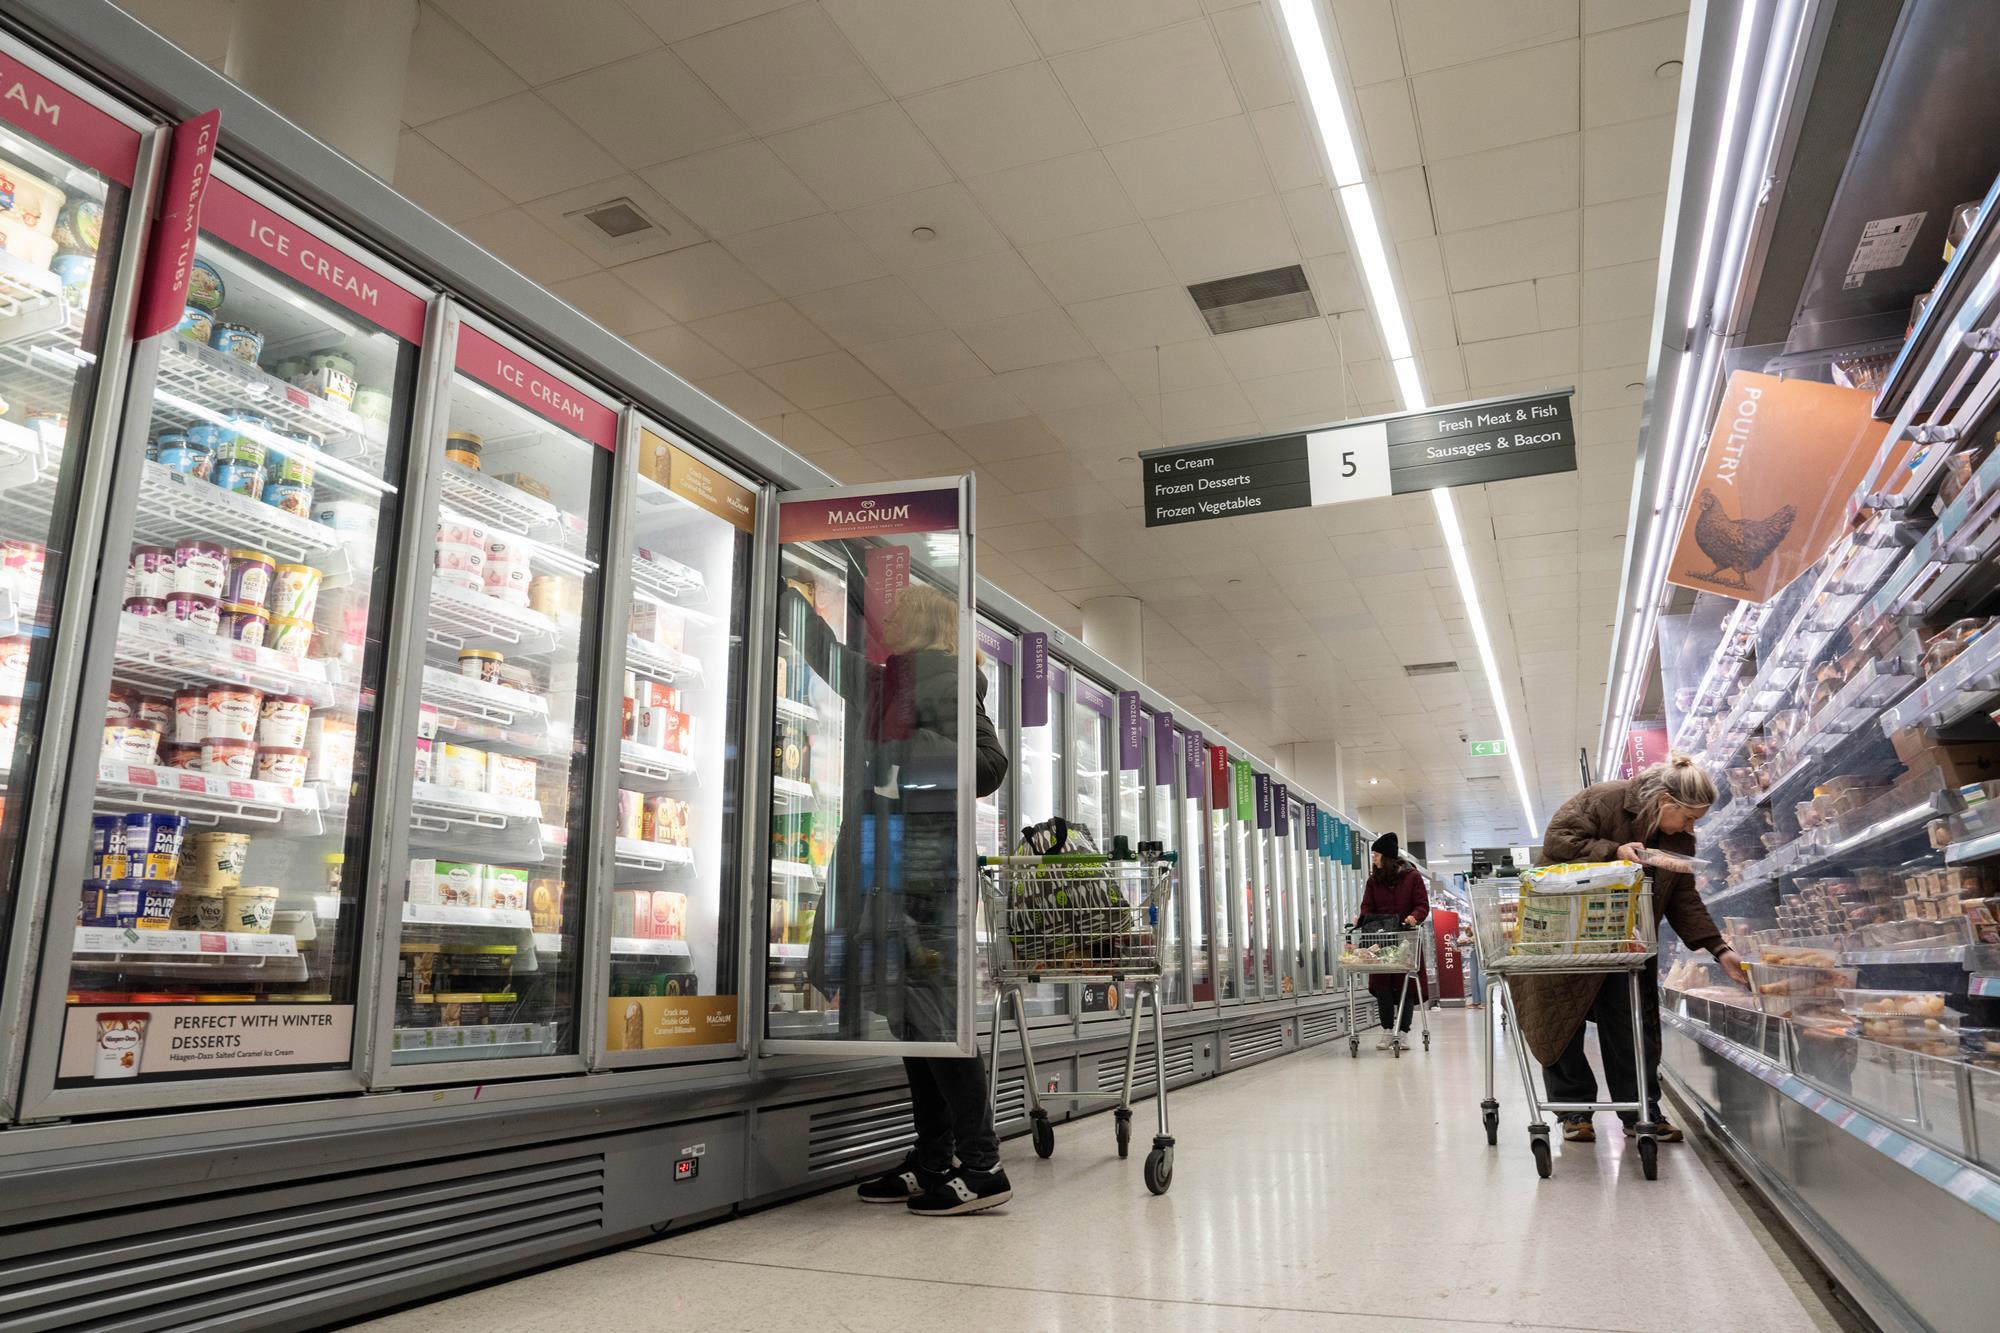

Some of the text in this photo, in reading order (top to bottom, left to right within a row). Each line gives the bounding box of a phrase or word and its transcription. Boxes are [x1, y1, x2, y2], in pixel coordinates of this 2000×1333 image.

[0, 72, 60, 127] AM
[171, 122, 211, 293] ICE CREAM TUBS
[249, 218, 380, 307] ICE CREAM
[497, 359, 585, 422] ICE CREAM
[1438, 404, 1558, 433] Fresh Meat & Fish
[1426, 431, 1561, 459] Sausages & Bacon
[1716, 386, 1762, 486] POULTRY
[1154, 457, 1215, 474] Ice Cream
[1341, 451, 1357, 477] 5
[1155, 475, 1251, 496] Frozen Desserts
[726, 496, 750, 514] MAGNUM
[827, 504, 912, 525] MAGNUM
[1156, 495, 1262, 519] Frozen Vegetables
[976, 630, 1001, 651] ESSERTS
[1035, 638, 1043, 680] DESSERTS
[1129, 695, 1138, 749] FROZEN FRUIT
[1634, 736, 1645, 763] DUCK
[153, 842, 180, 855] MILK
[143, 906, 172, 918] MILK
[201, 905, 220, 915] Yeo
[1443, 933, 1454, 969] OFFERS
[1084, 988, 1094, 1002] Gü
[173, 1014, 333, 1029] PERFECT WITH WINTER
[663, 1008, 689, 1016] Crack into
[678, 1016, 690, 1025] Gold
[706, 1014, 732, 1024] MAGNUM
[171, 1034, 241, 1050] DESSERTS
[169, 1052, 214, 1062] Häagen-Dazs
[215, 1051, 236, 1059] Salted
[236, 1050, 263, 1058] Caramel
